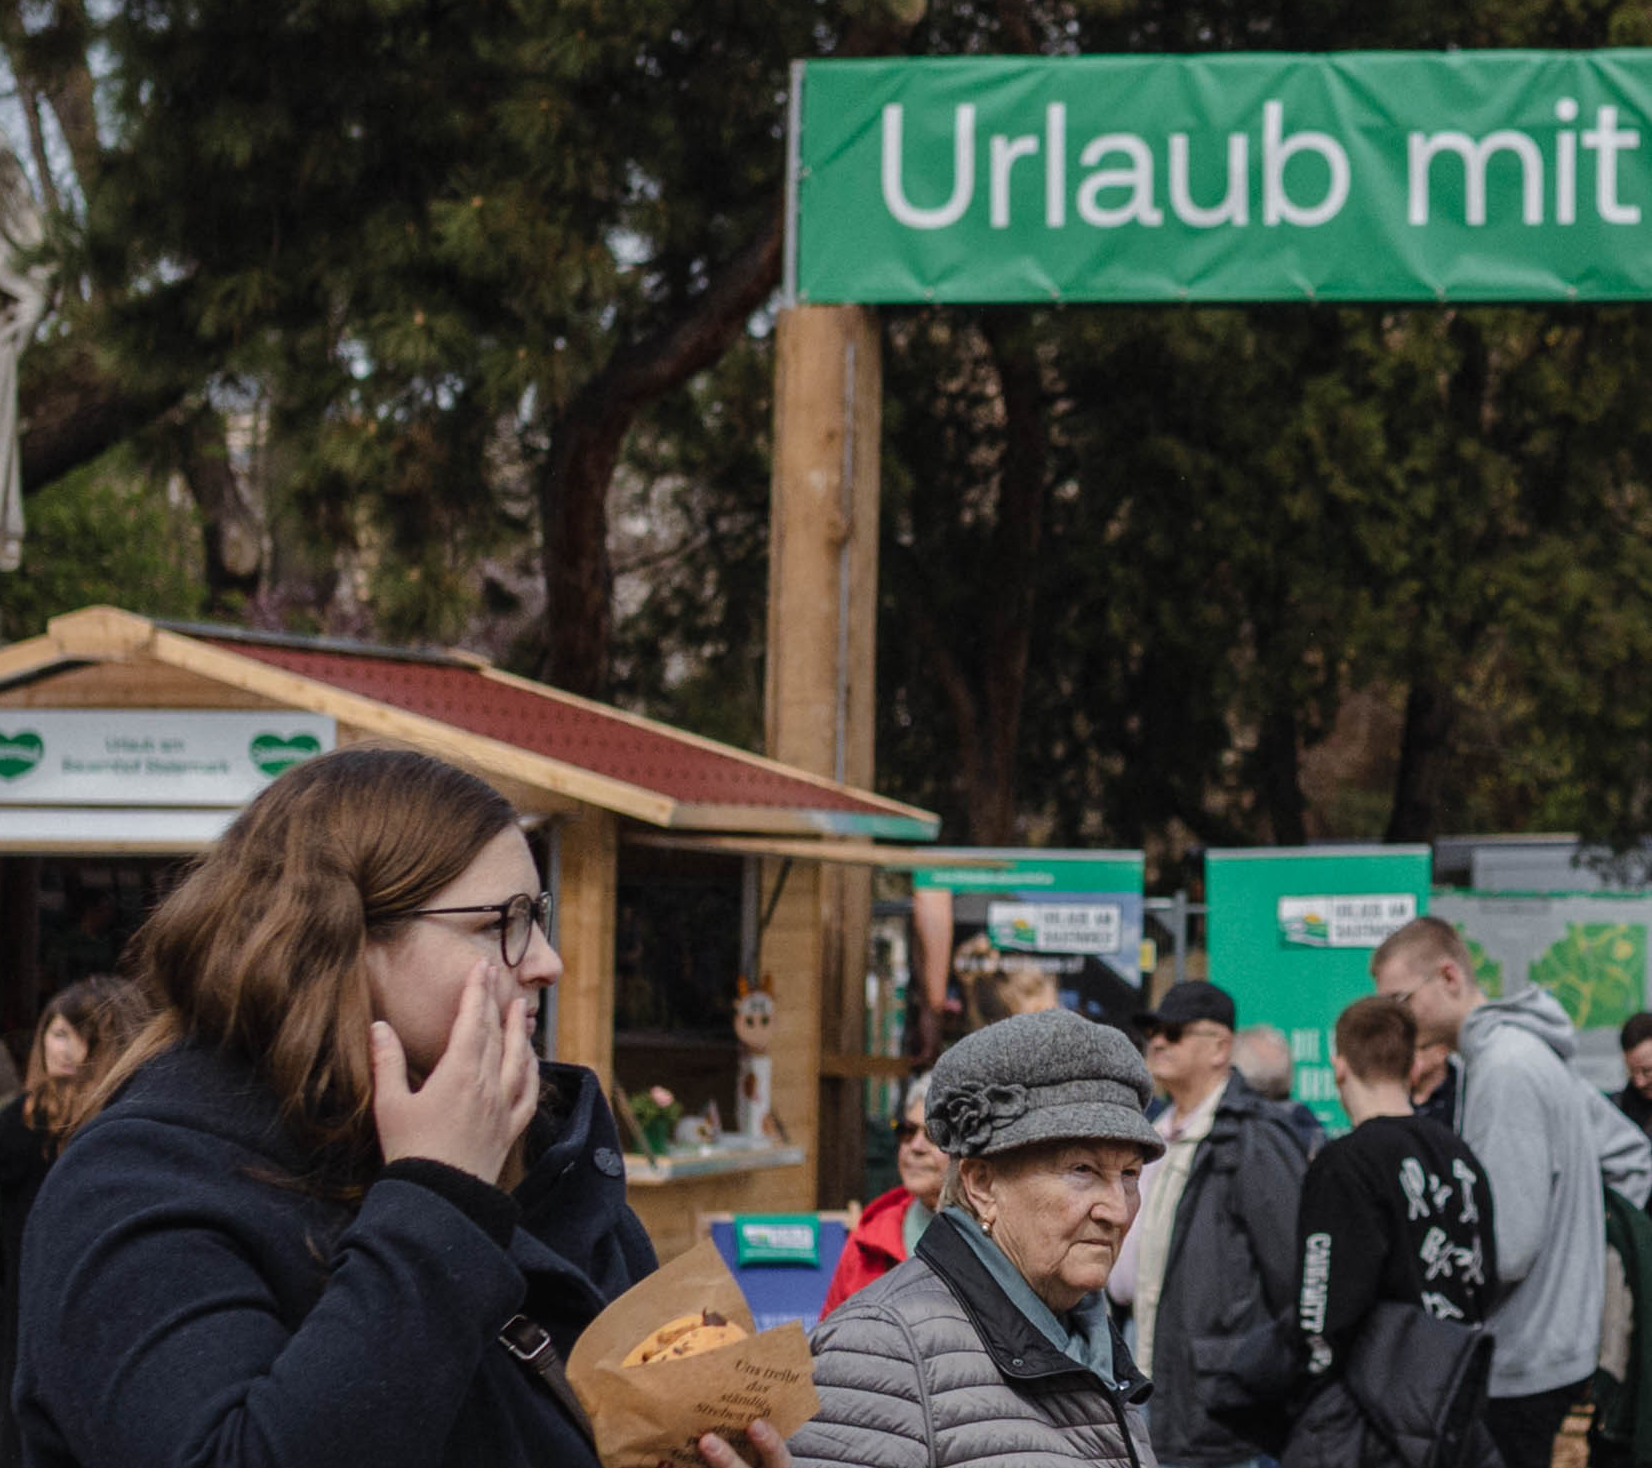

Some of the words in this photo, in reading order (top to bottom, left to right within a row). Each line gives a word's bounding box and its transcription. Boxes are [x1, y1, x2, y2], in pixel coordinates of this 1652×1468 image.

[881, 99, 1350, 230] Urlaub
[1408, 96, 1642, 227] mit
[735, 1359, 761, 1376] Uns
[763, 1368, 801, 1385] treibt
[745, 1380, 771, 1394] das
[721, 1393, 768, 1411] ständi
